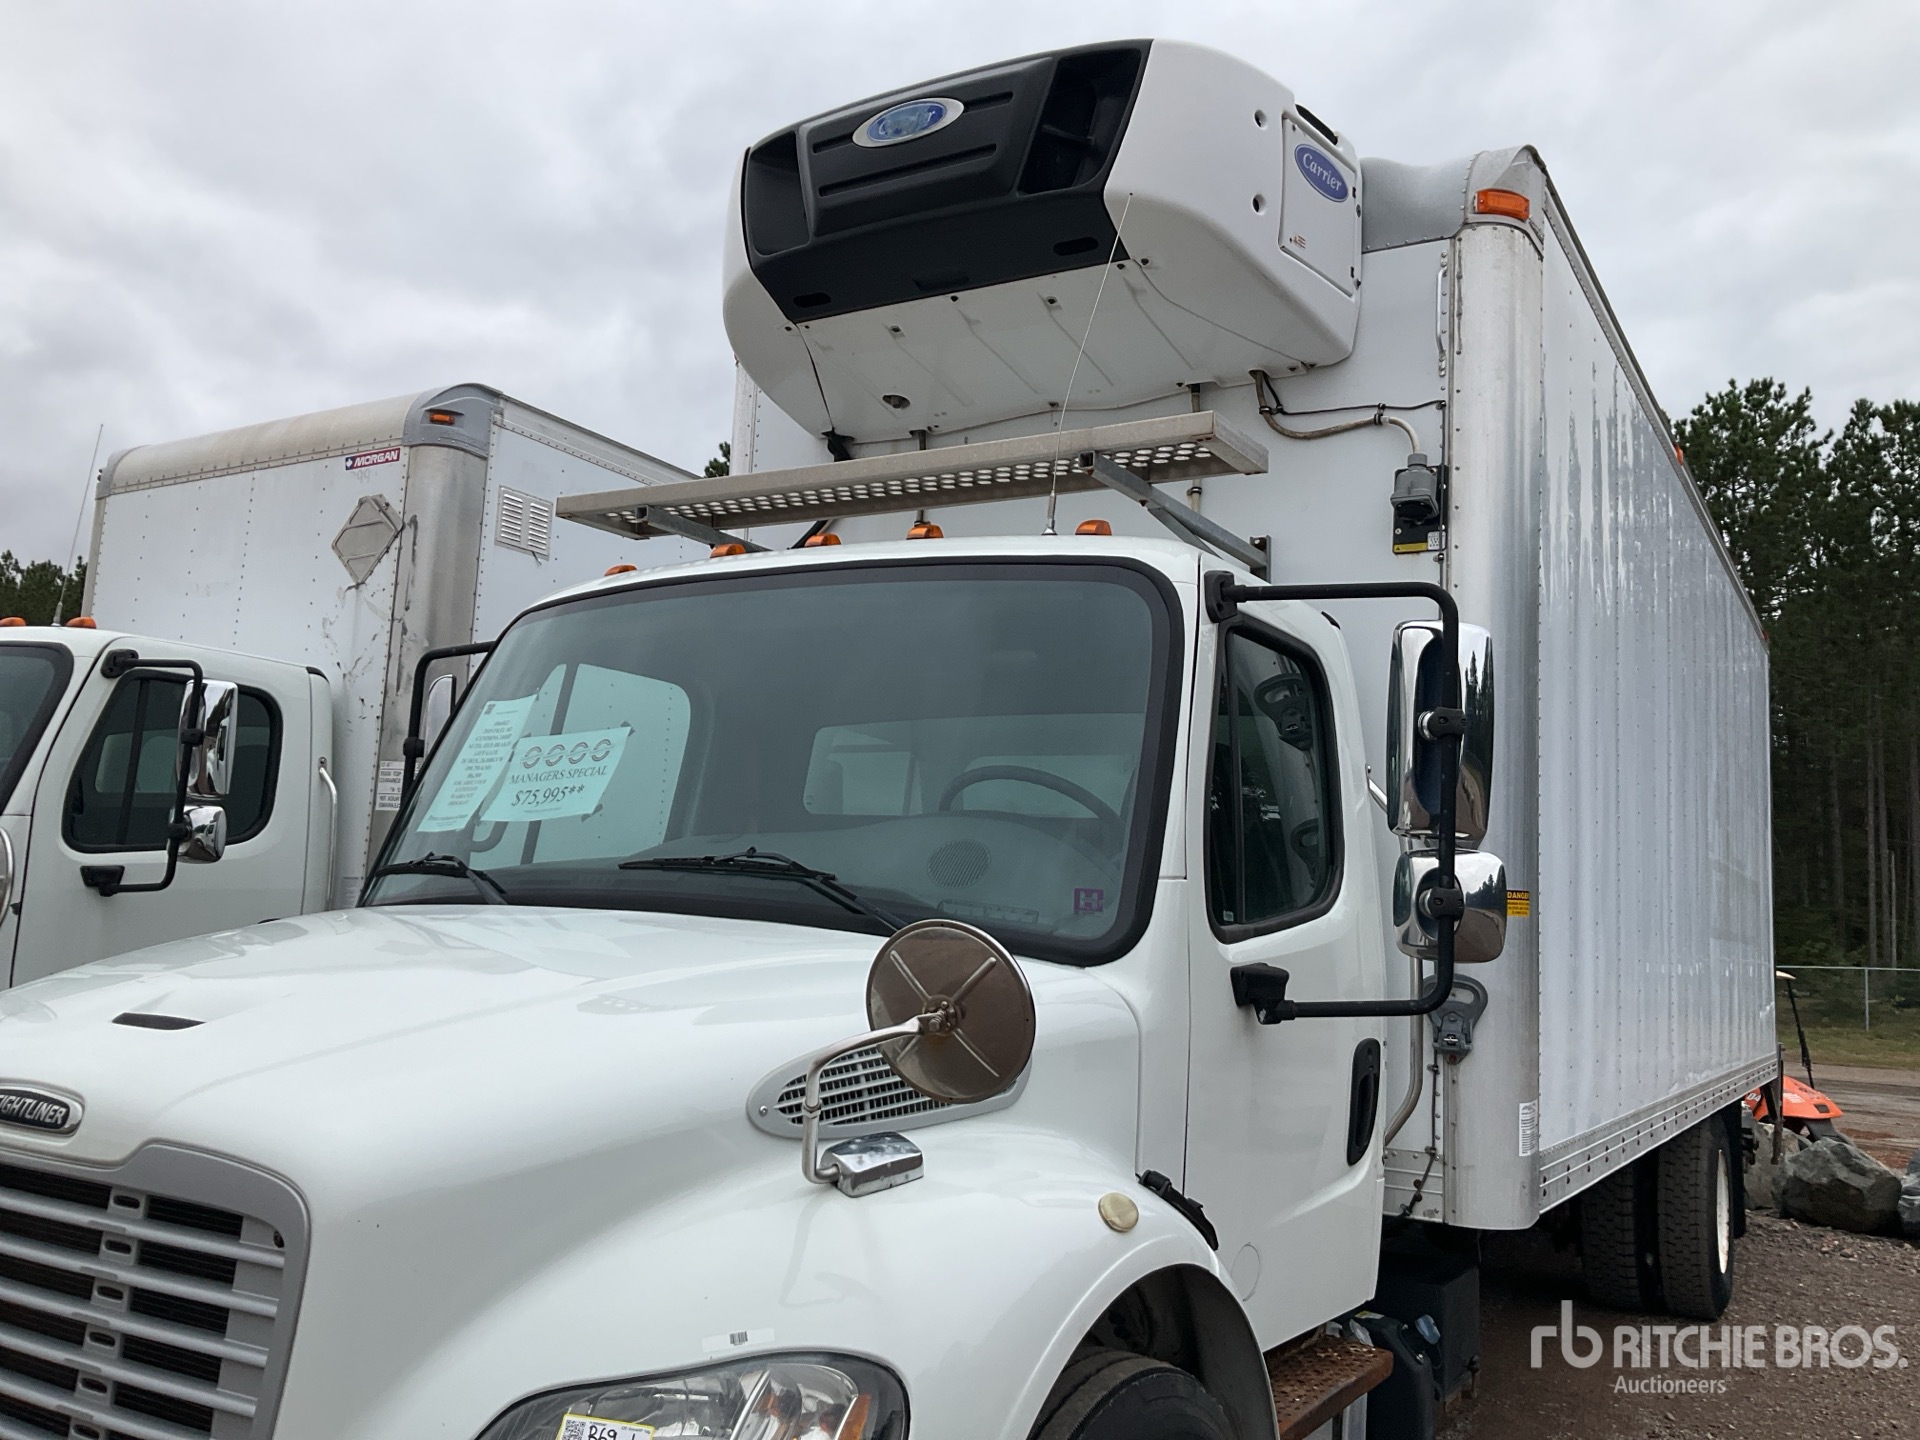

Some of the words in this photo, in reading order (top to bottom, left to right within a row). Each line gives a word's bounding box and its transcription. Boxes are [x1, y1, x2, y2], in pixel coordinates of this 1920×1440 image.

[1302, 152, 1342, 191] Carrier
[353, 450, 399, 467] MORGAN
[509, 769, 567, 785] MANAGERS
[567, 765, 608, 780] SPECIAL
